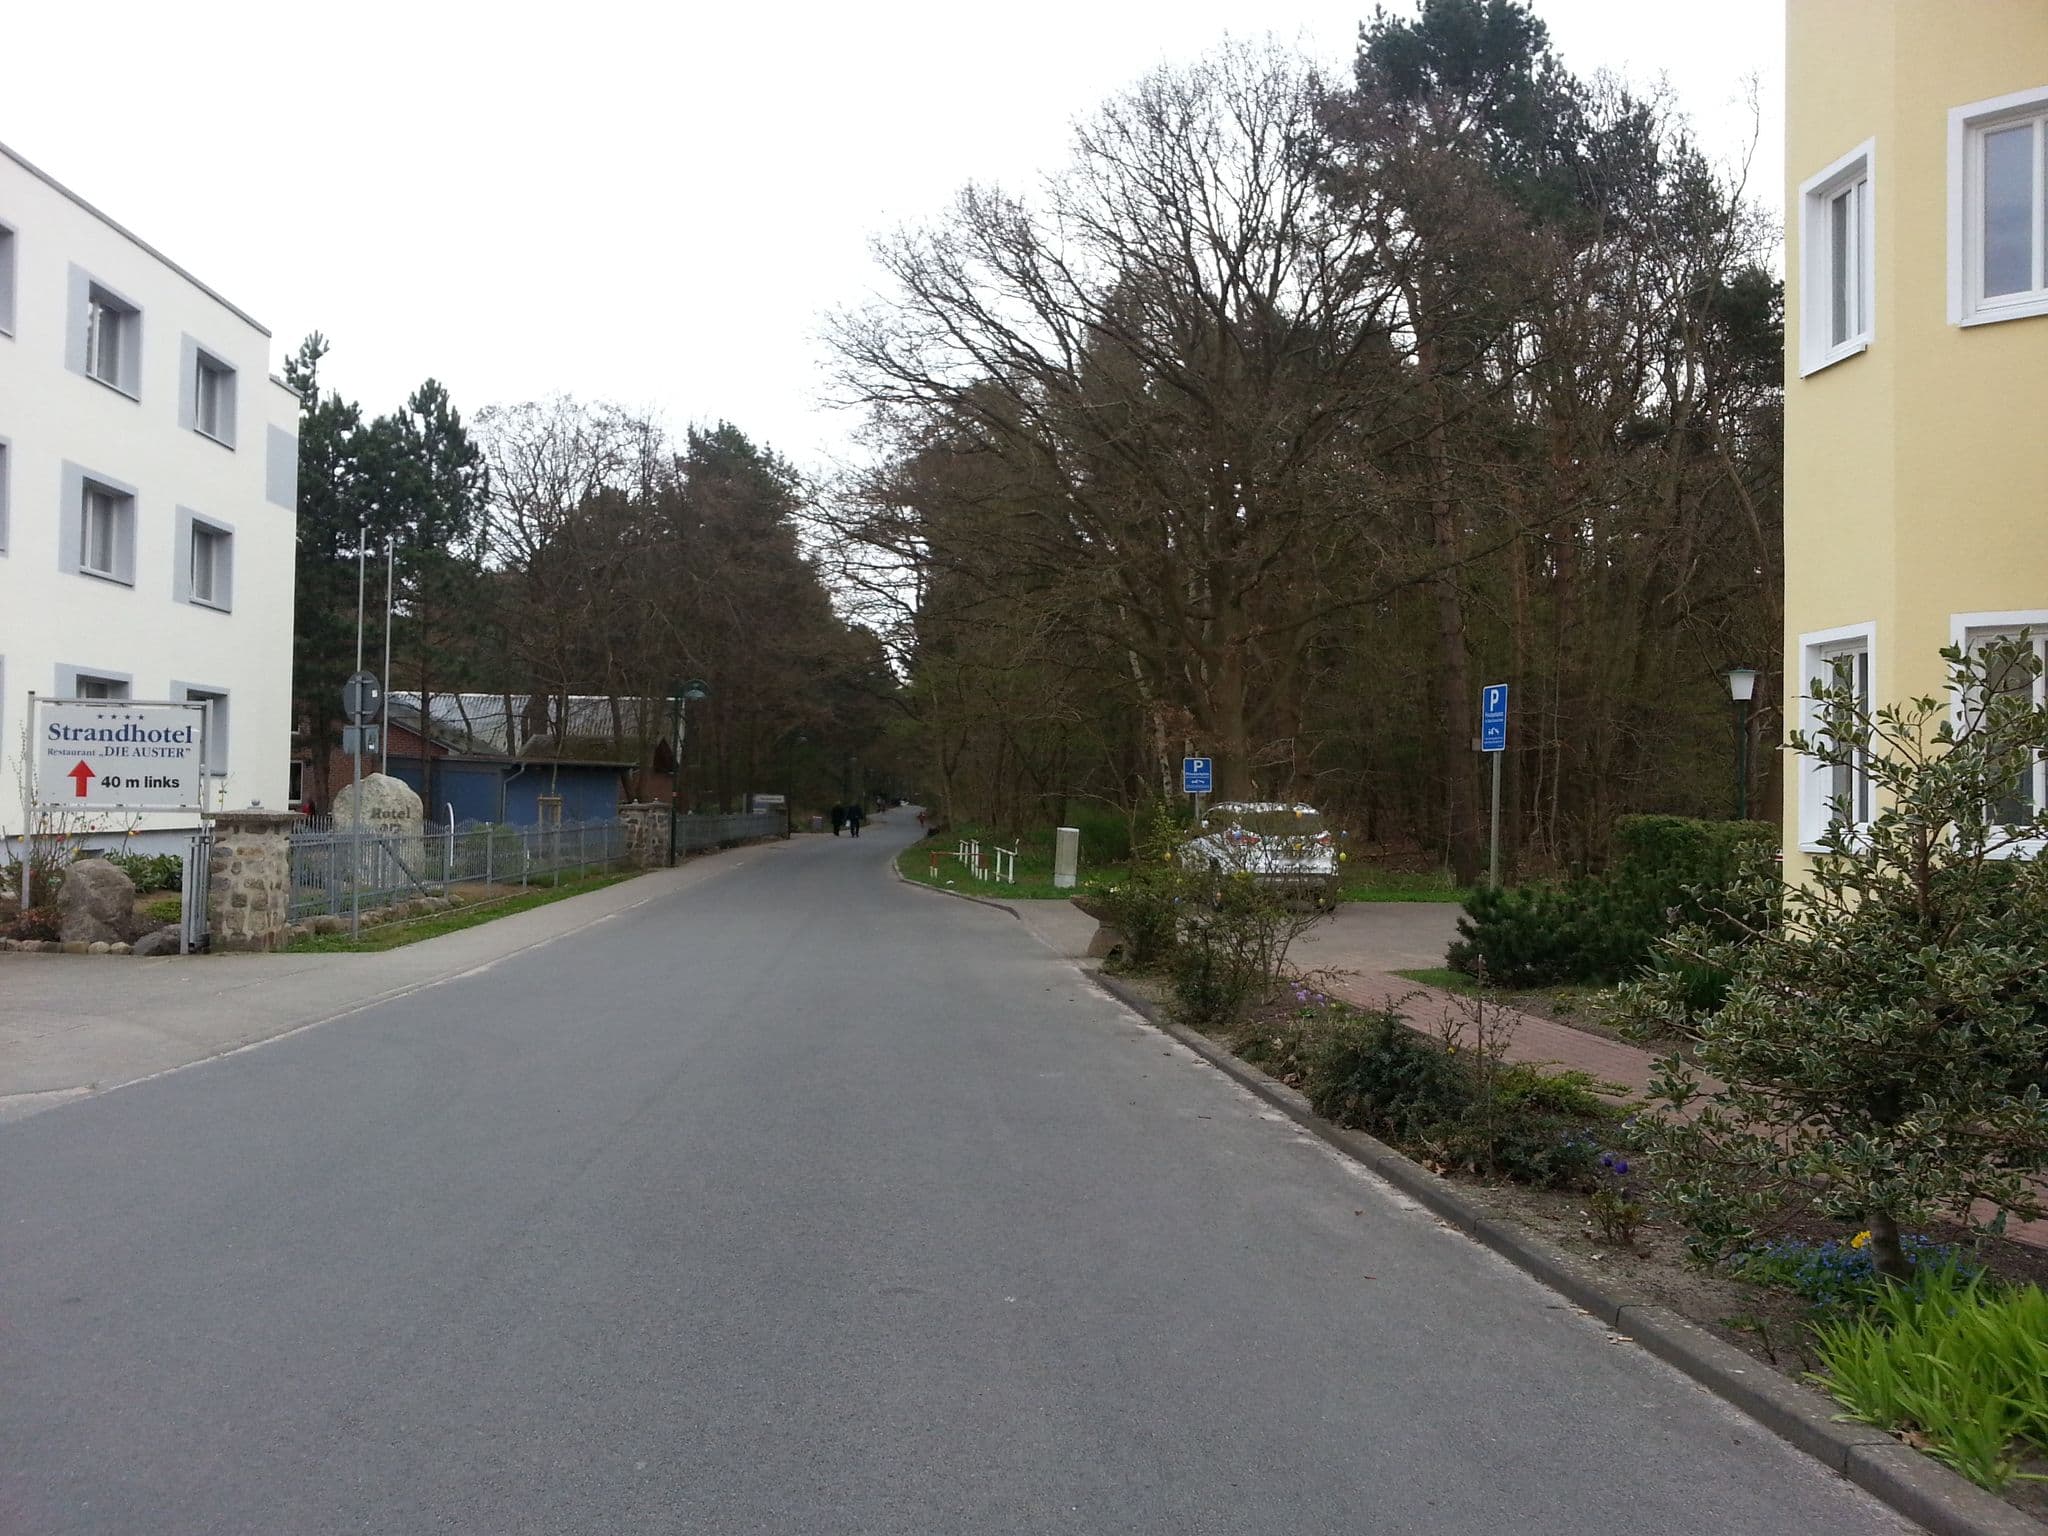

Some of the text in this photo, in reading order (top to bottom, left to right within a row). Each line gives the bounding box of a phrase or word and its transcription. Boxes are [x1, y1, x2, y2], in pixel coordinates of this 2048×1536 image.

[1490, 689, 1499, 712] P
[48, 722, 193, 744] Strandhotel
[47, 748, 96, 757] Restaurant
[1193, 760, 1204, 772] P
[101, 776, 180, 788] 40 m links
[371, 806, 411, 819] Hotel
